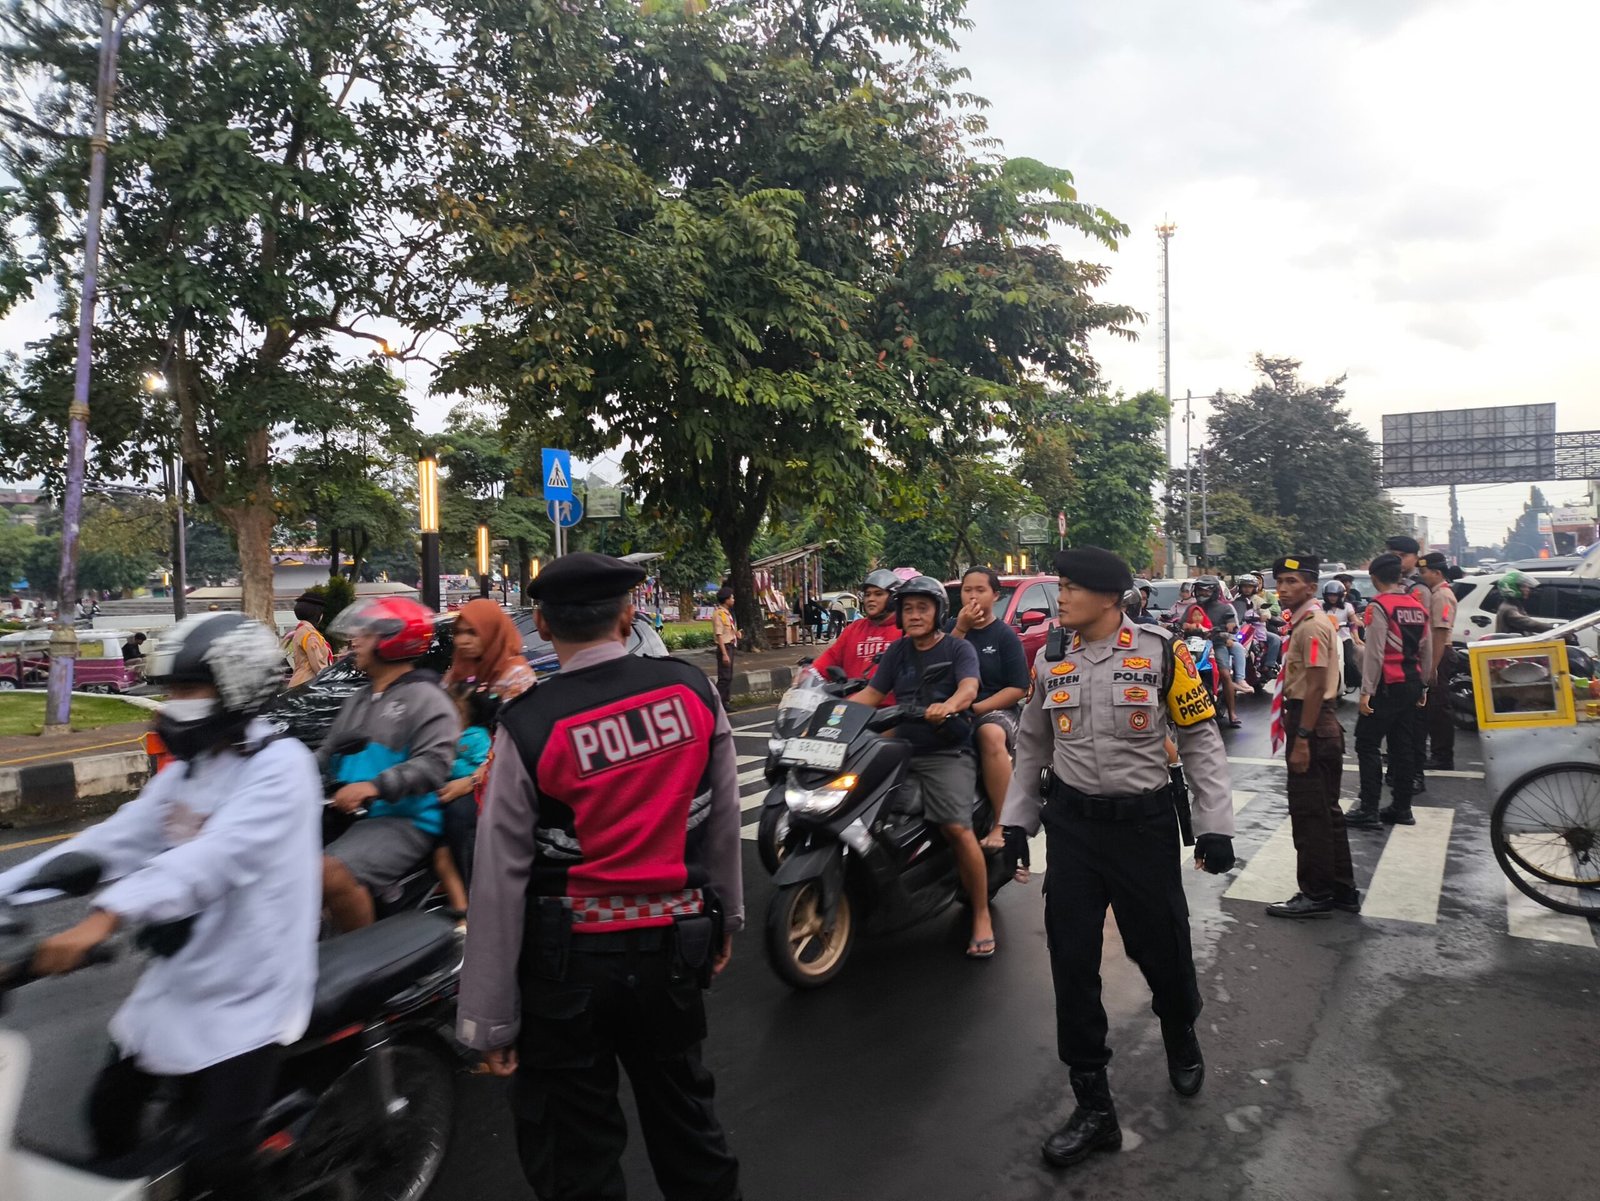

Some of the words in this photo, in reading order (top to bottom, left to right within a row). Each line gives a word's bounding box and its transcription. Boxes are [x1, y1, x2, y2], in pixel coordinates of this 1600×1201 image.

[1396, 609, 1425, 623] POLISI
[1047, 674, 1080, 689] ZEZEN
[1113, 672, 1158, 684] POLRI
[572, 697, 693, 772] POLISI
